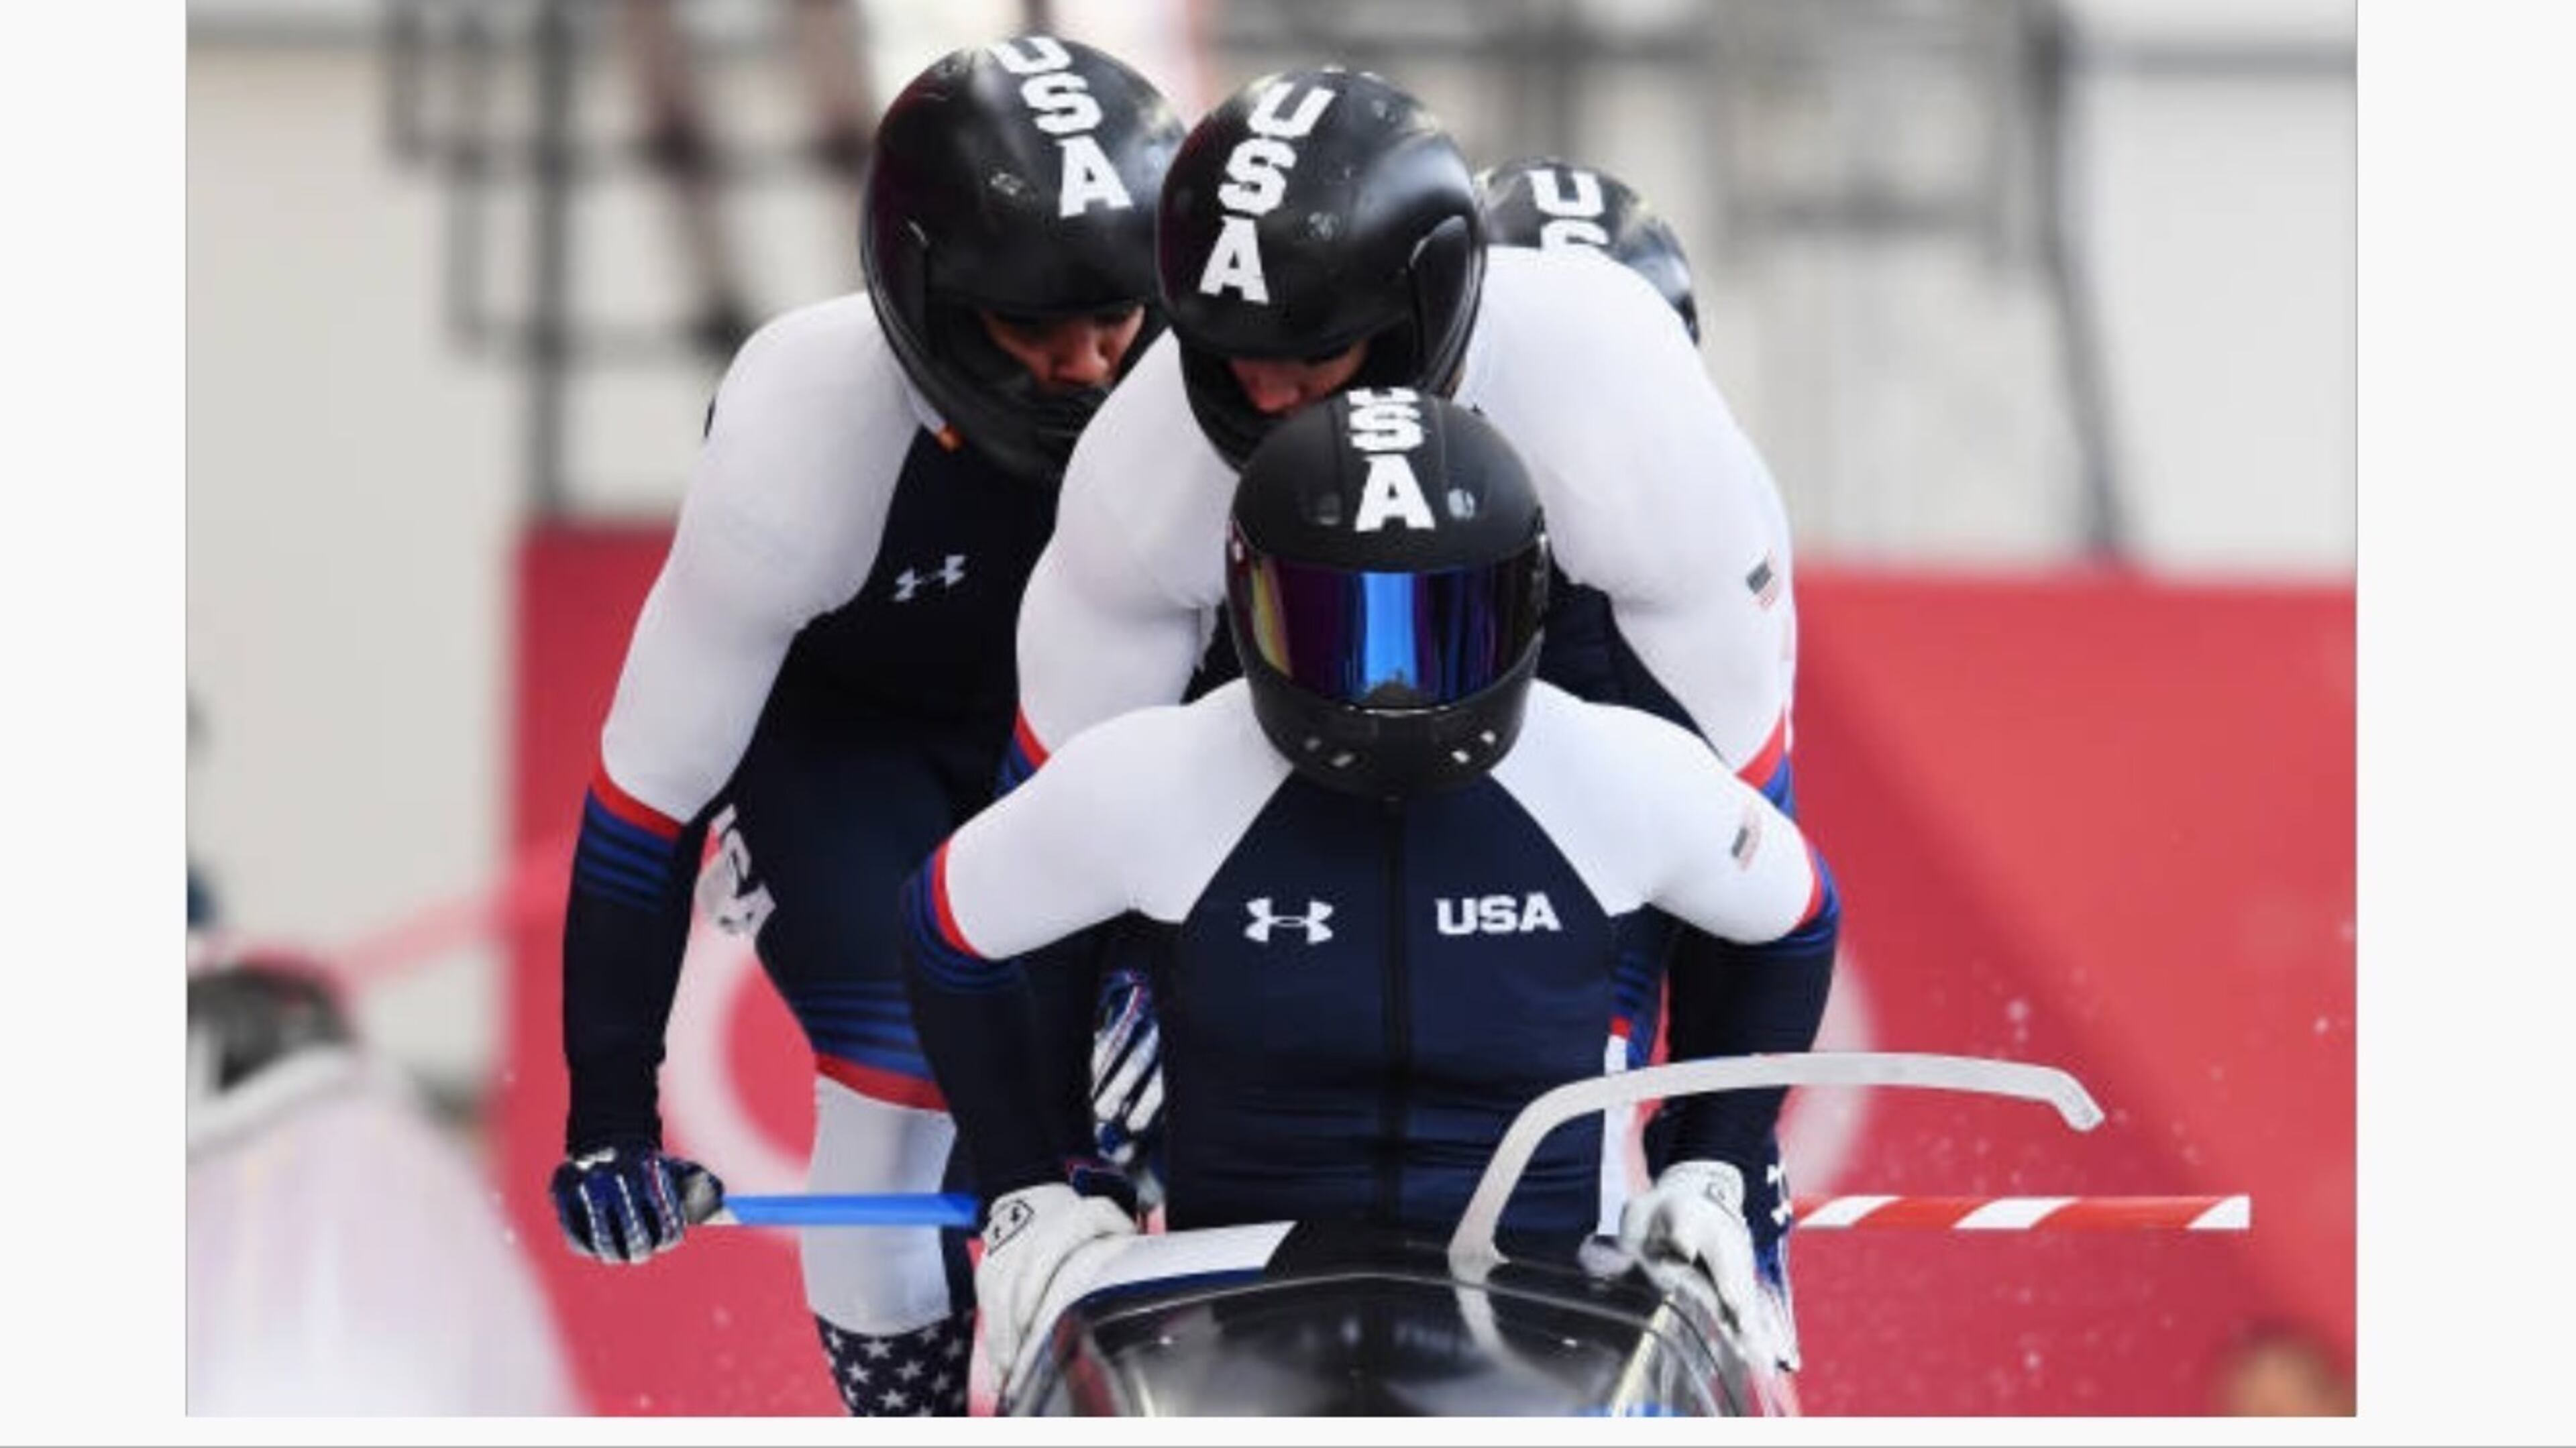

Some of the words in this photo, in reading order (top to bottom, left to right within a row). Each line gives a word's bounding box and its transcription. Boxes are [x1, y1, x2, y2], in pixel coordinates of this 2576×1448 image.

[993, 36, 1133, 219] USA
[1199, 82, 1336, 306] USA
[1435, 892, 1562, 936] USA
